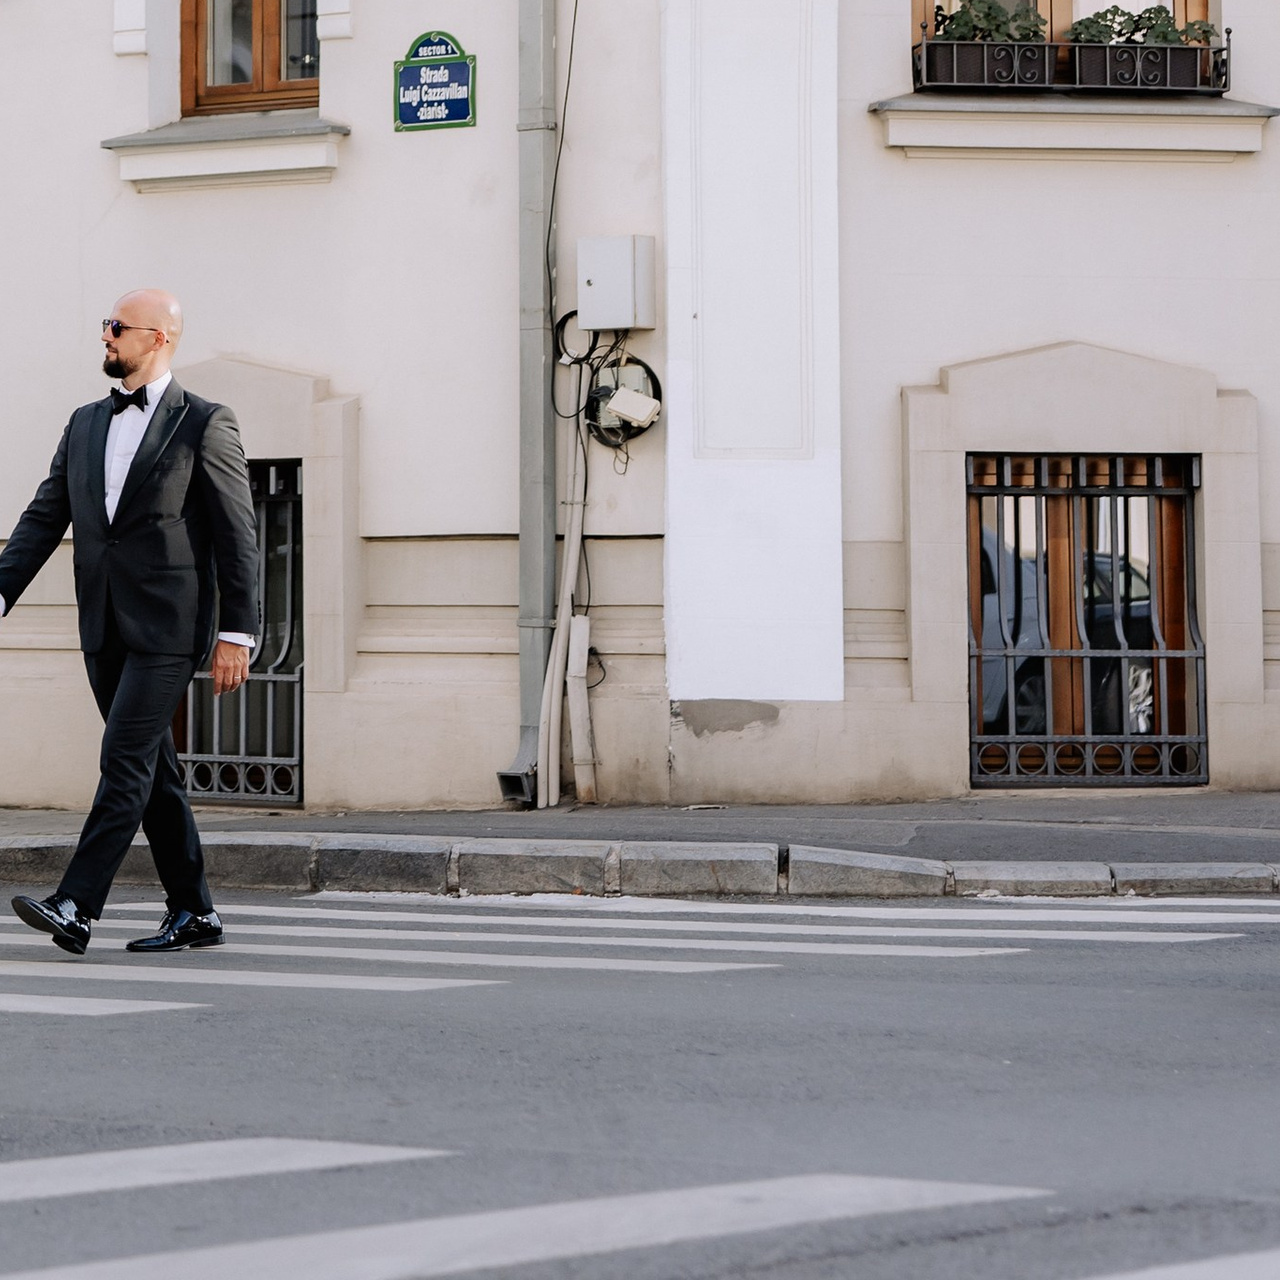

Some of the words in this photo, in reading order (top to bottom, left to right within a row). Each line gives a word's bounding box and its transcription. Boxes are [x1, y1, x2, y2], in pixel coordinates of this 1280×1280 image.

[418, 45, 447, 56] SECTOR
[447, 44, 452, 54] 1
[420, 65, 449, 84] Strada
[399, 85, 421, 107] Luigi
[421, 82, 468, 102] Cazzavillan
